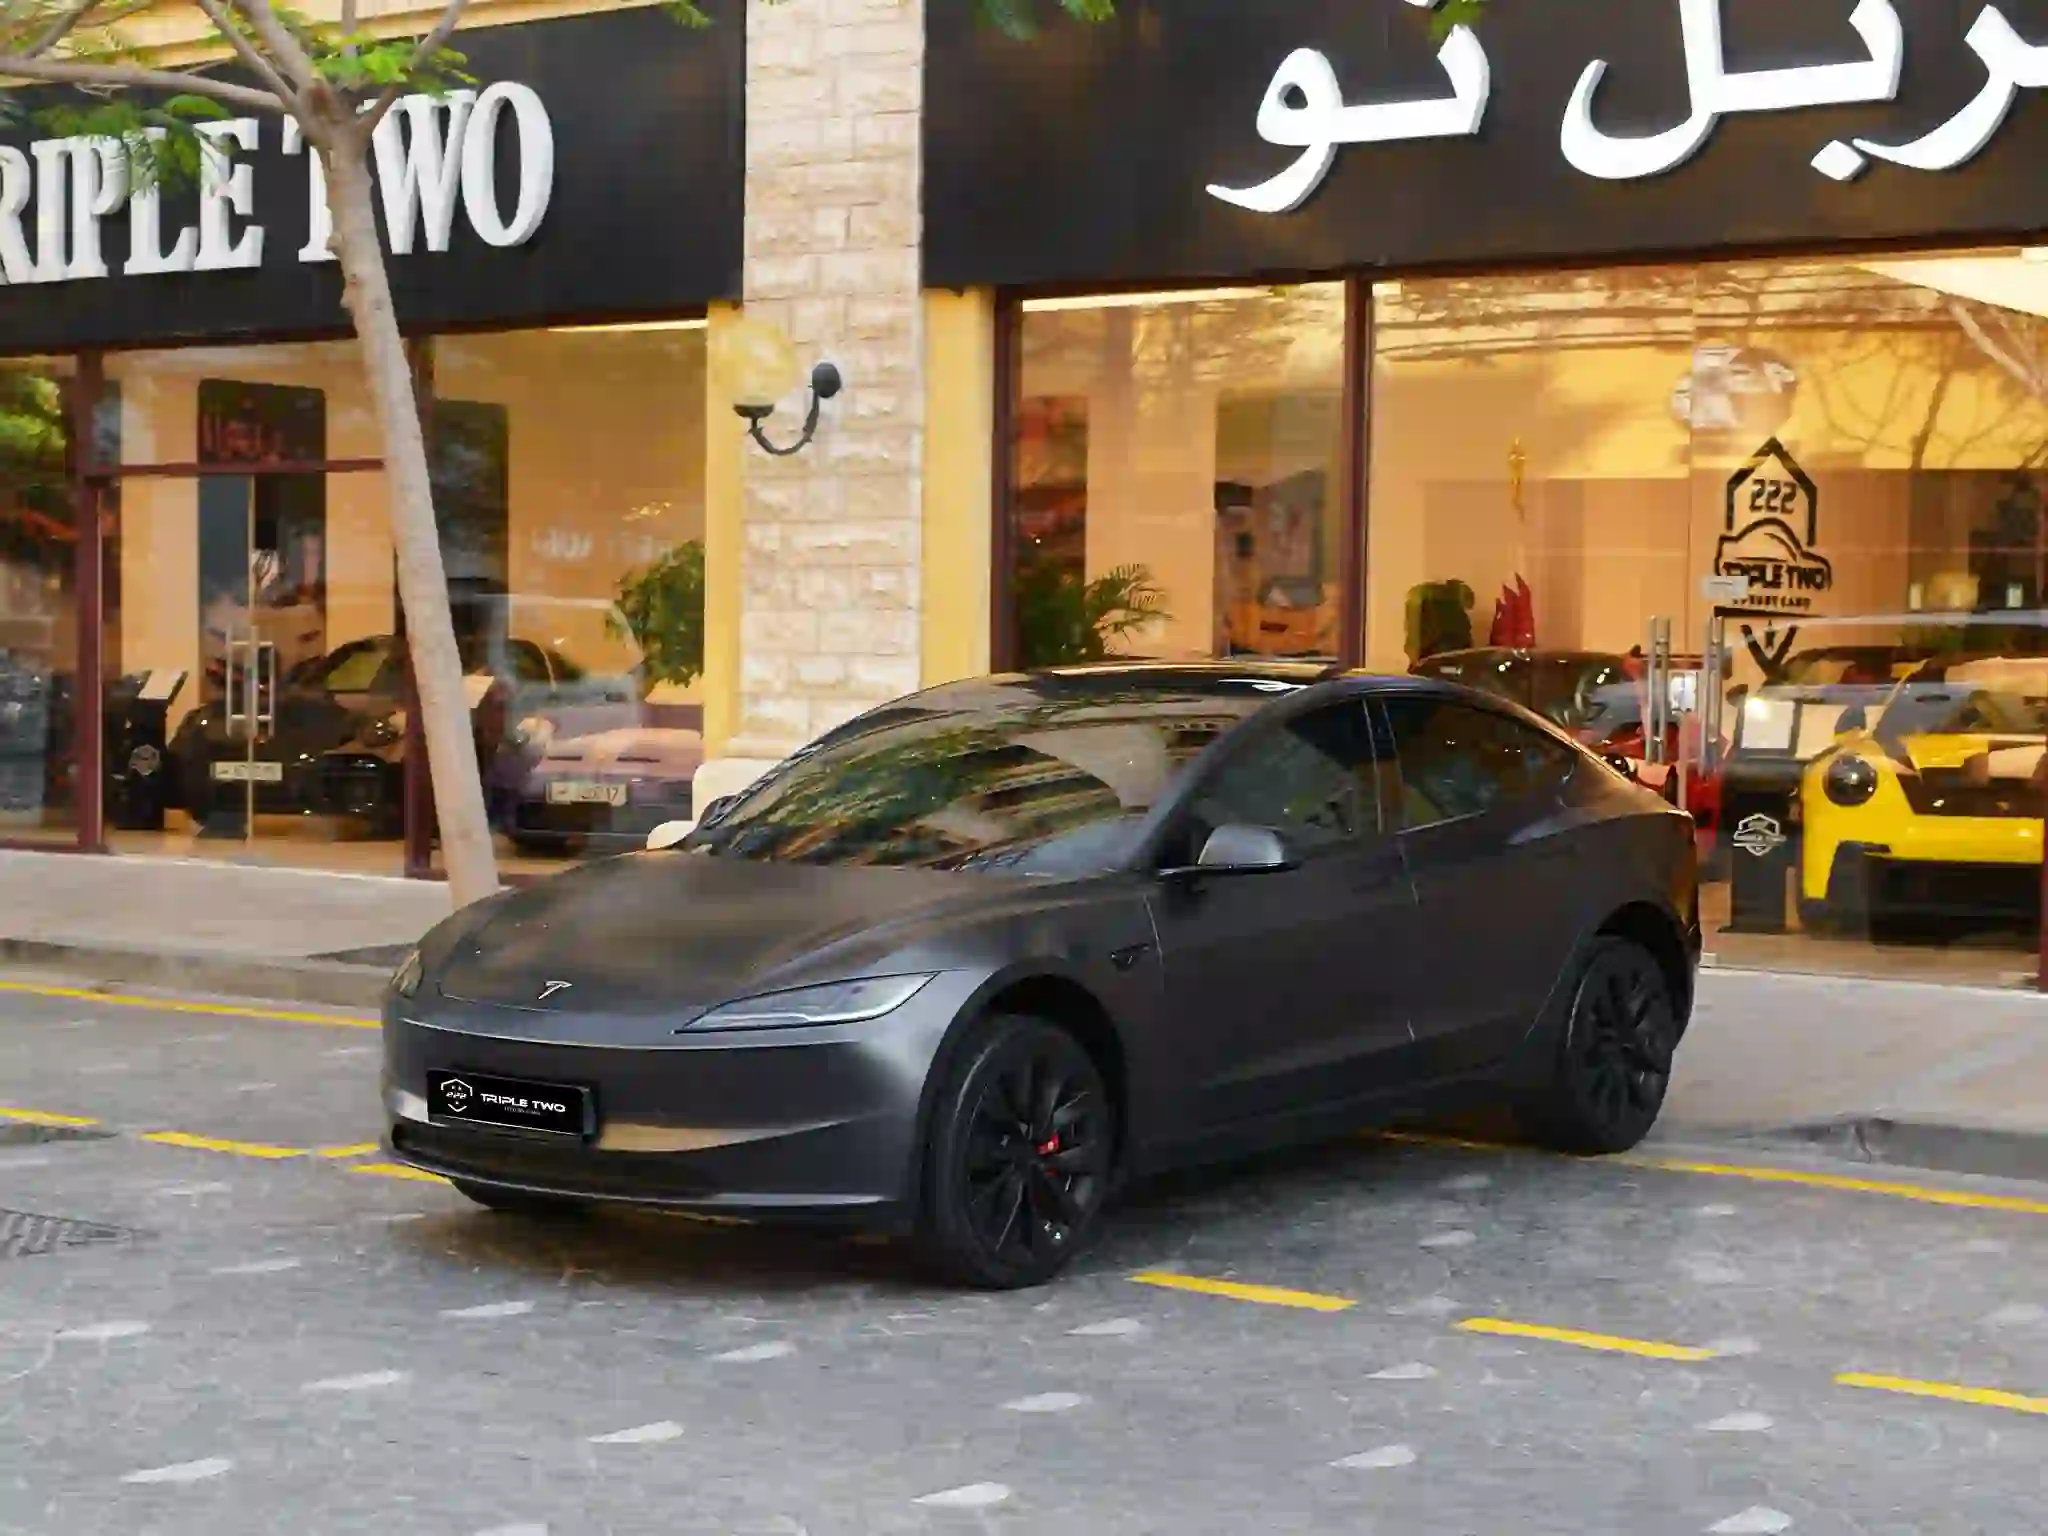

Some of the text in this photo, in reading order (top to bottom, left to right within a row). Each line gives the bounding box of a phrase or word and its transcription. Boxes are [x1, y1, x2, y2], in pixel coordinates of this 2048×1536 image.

[1561, 0, 2048, 181] ربل
[1749, 478, 1797, 515] 222
[1786, 565, 1827, 590] TWO
[480, 1093, 529, 1108] TRIPLE
[531, 1100, 567, 1113] TWO
